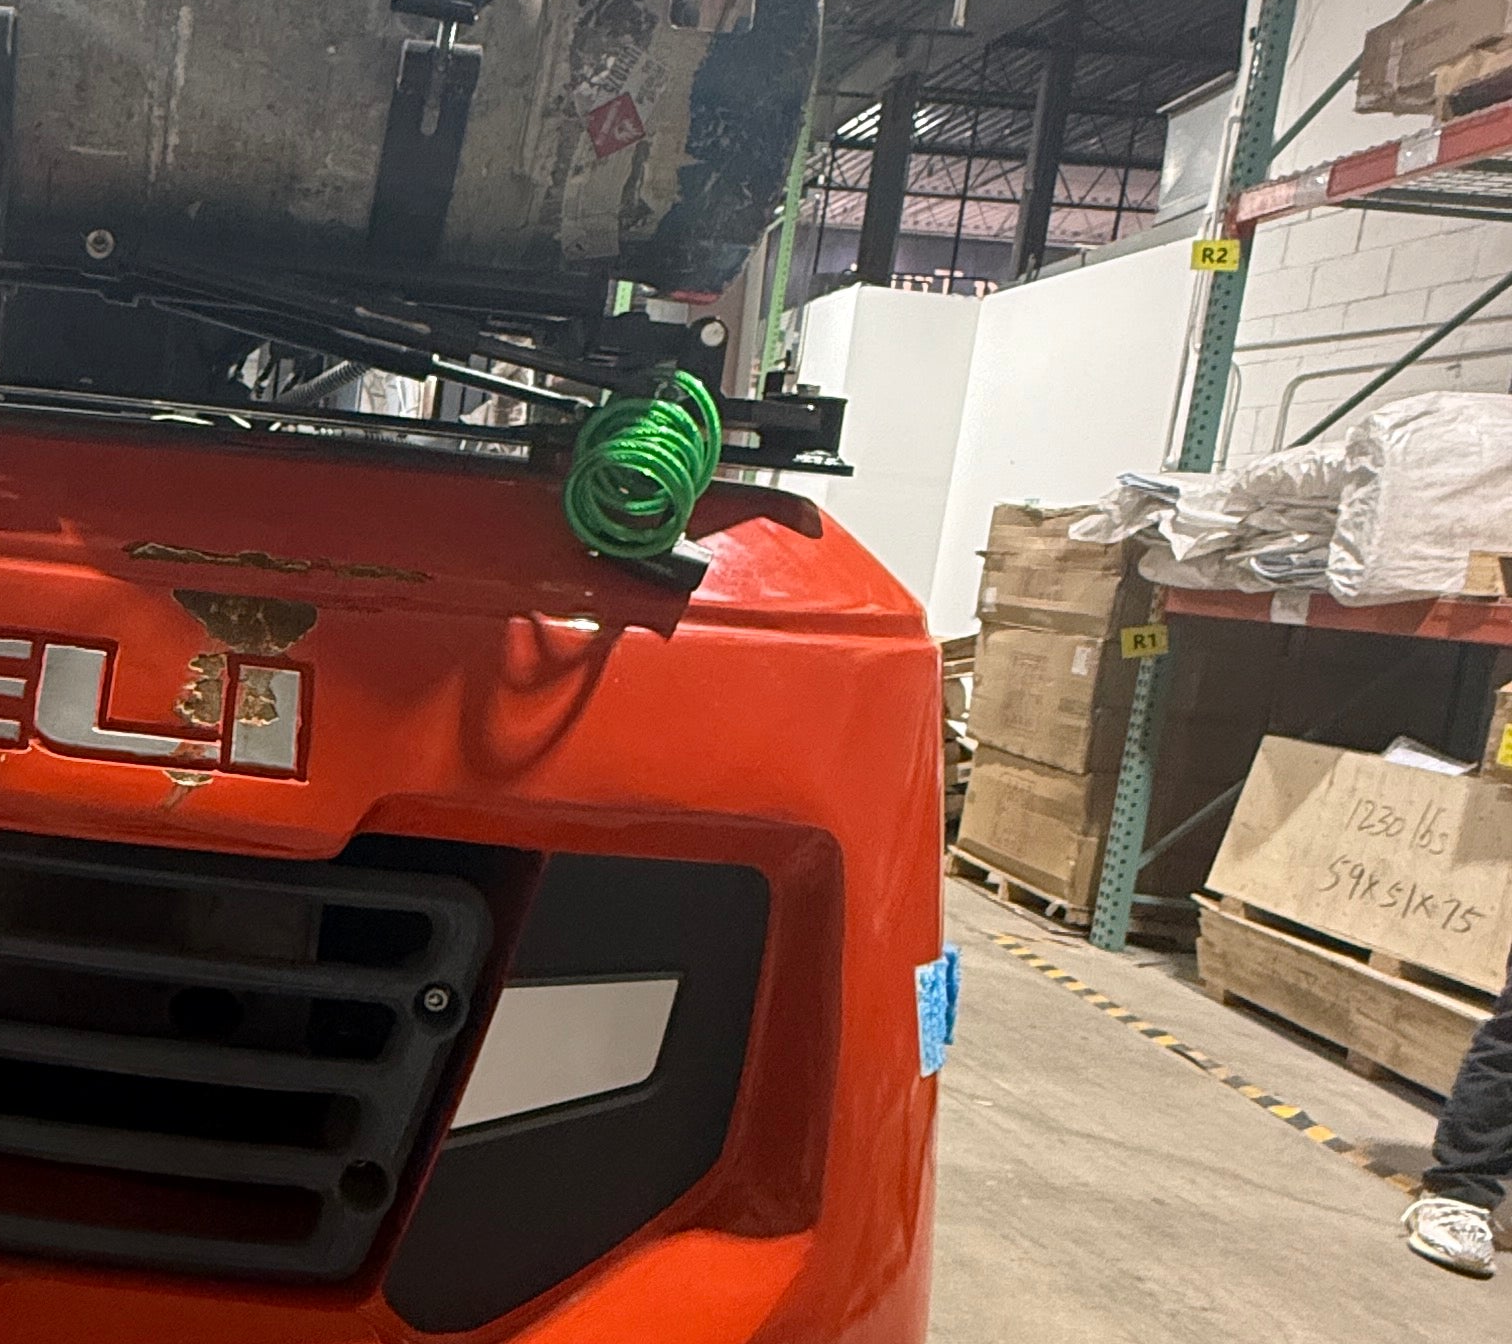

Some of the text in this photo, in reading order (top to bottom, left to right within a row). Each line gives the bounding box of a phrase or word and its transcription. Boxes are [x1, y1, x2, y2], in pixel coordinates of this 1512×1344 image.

[1201, 247, 1228, 265] R2
[1133, 633, 1156, 650] R1
[1344, 797, 1449, 855] 1230 lbs
